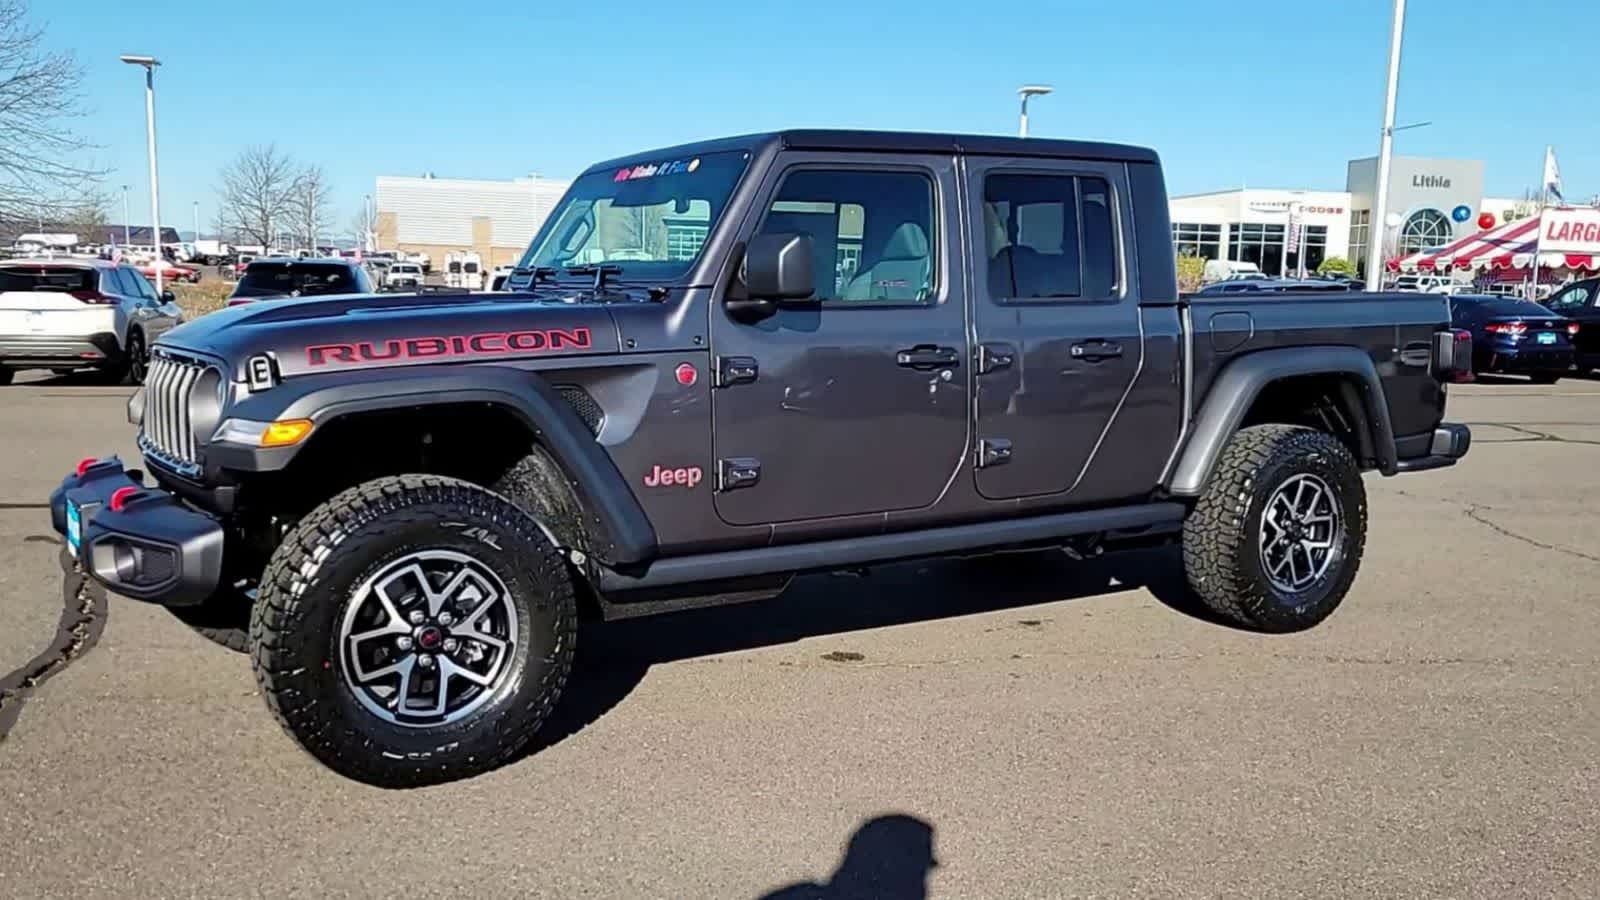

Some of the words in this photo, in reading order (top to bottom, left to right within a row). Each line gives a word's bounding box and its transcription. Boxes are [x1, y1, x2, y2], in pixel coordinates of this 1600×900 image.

[1412, 175, 1452, 188] Lithia
[307, 328, 592, 366] RUBICON
[644, 465, 702, 487] Jeep
